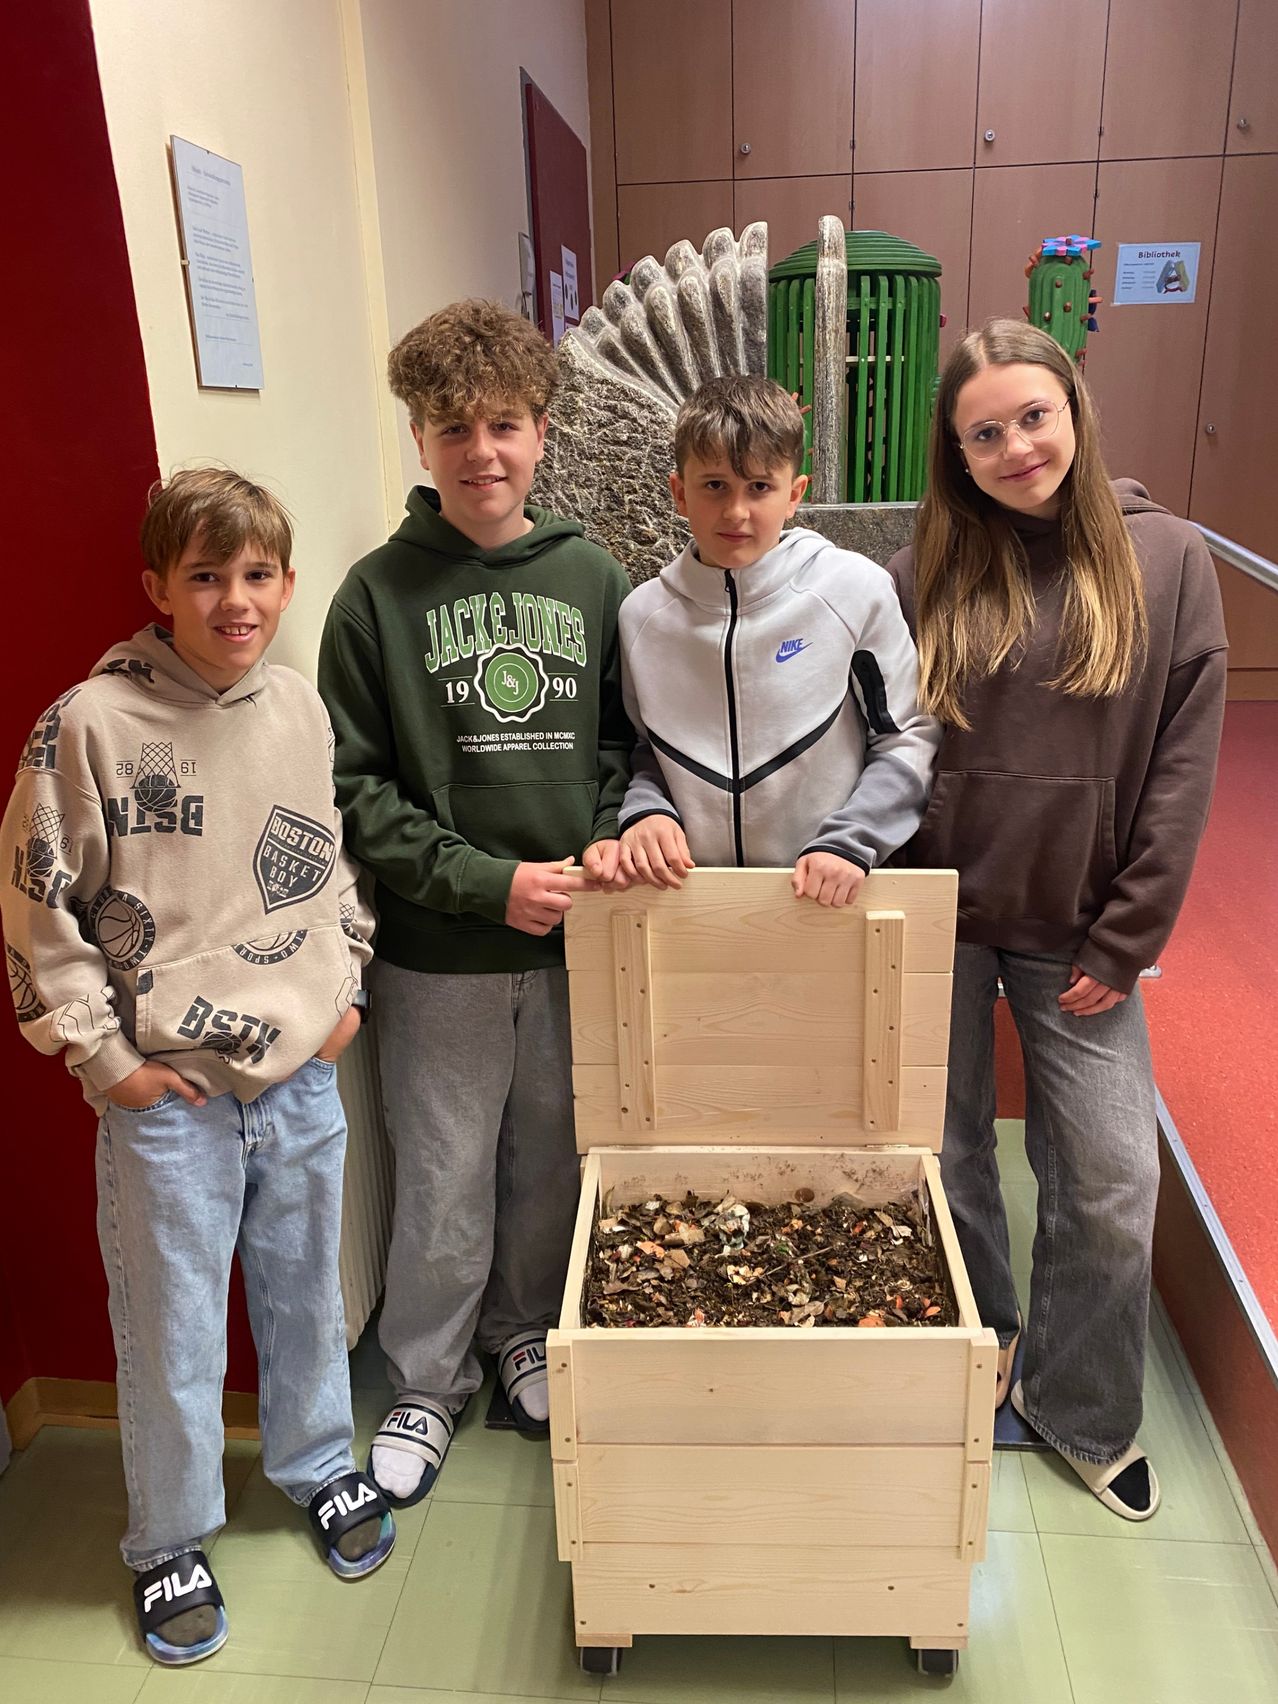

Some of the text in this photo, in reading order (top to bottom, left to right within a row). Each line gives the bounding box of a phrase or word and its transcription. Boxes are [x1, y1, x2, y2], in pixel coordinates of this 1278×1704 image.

[1138, 250, 1181, 259] Bibliothek
[780, 638, 803, 653] NIKE
[445, 677, 577, 704] 19 90
[501, 670, 519, 695] J&J
[457, 732, 576, 743] JACK&JONES ESTABLISHED IN MCMXC
[461, 742, 574, 753] WORLDWIDE APPAREL COLLECTION
[116, 761, 197, 776] 19 82
[270, 815, 334, 863] BOSTON
[263, 844, 322, 882] BASKET
[269, 865, 298, 888] BOY
[512, 1346, 547, 1371] FIL
[385, 1411, 429, 1436] FILA
[318, 1482, 378, 1530] FILA
[144, 1563, 213, 1614] FILA
